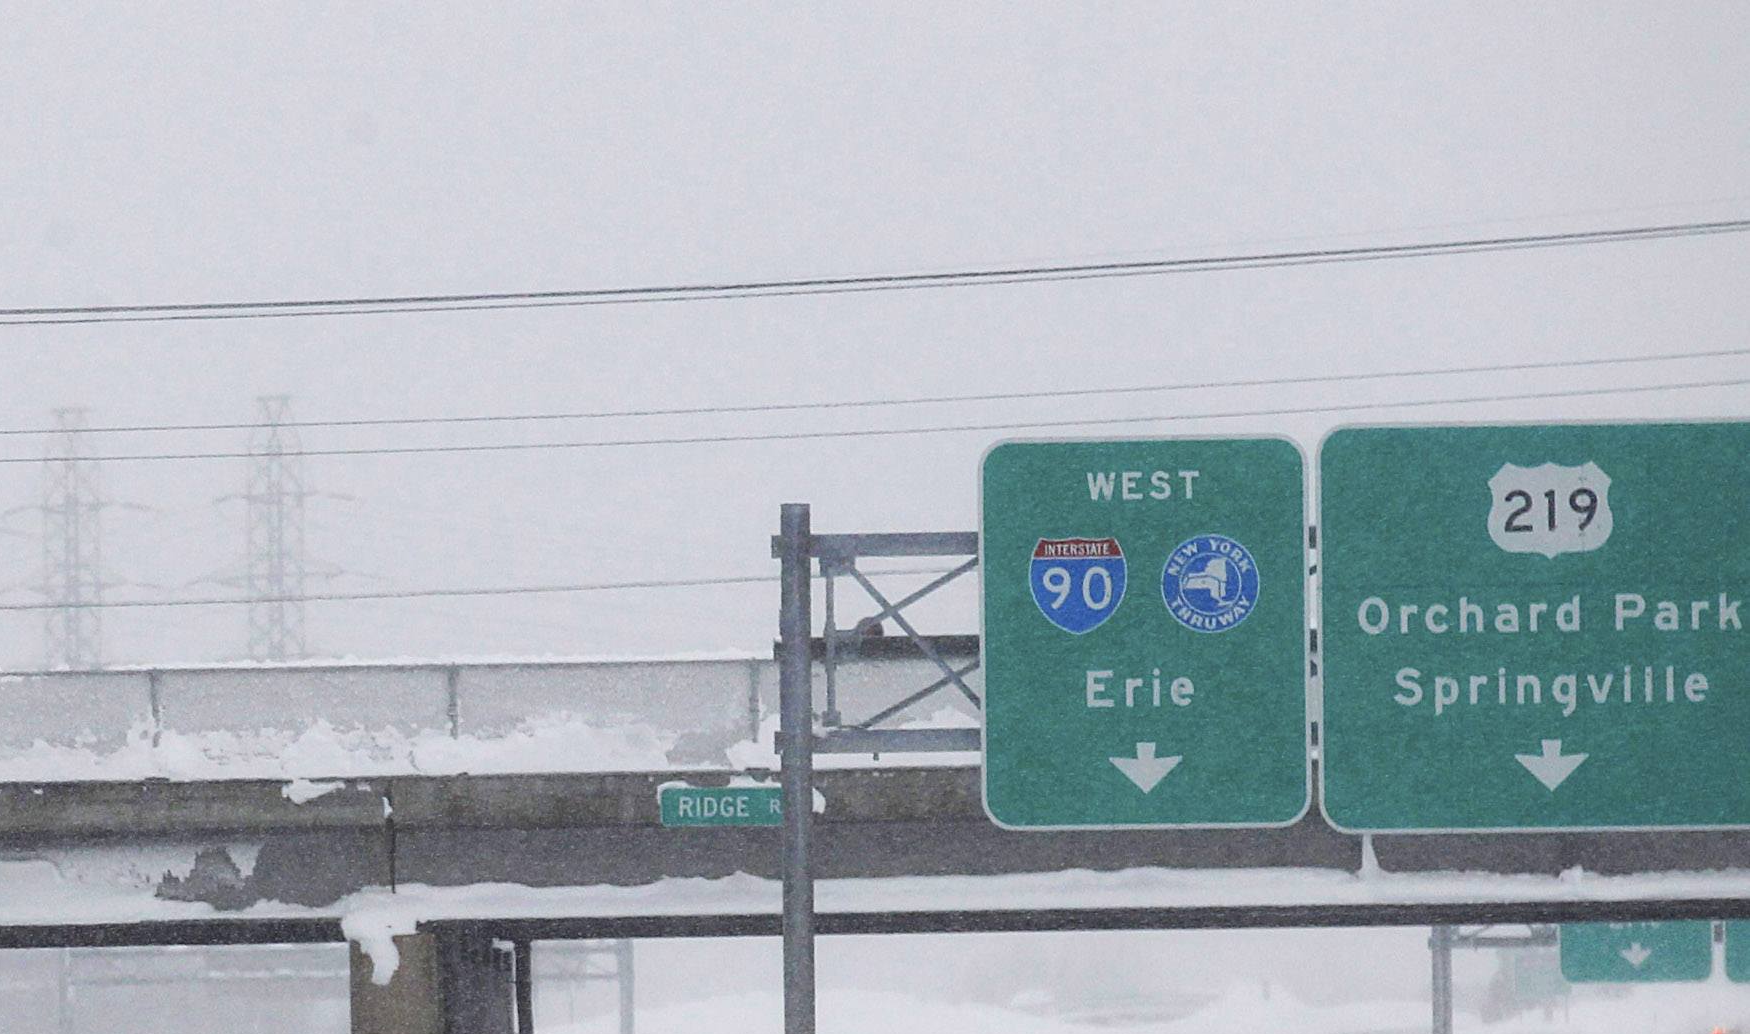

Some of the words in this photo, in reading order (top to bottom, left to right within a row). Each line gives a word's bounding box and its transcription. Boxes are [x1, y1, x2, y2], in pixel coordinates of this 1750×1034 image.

[1088, 471, 1200, 501] WEST
[1504, 488, 1598, 533] 219
[1044, 543, 1111, 556] INTERSTATE
[1168, 542, 1197, 576] NEW
[1208, 538, 1251, 573] YORK
[1043, 566, 1112, 610] 90
[1171, 594, 1251, 630] THRUWAY
[1358, 596, 1581, 635] Orchard
[1616, 594, 1742, 632] Park
[1087, 669, 1196, 708] Erie
[1394, 667, 1710, 717] Springville
[678, 796, 750, 818] RIDGE
